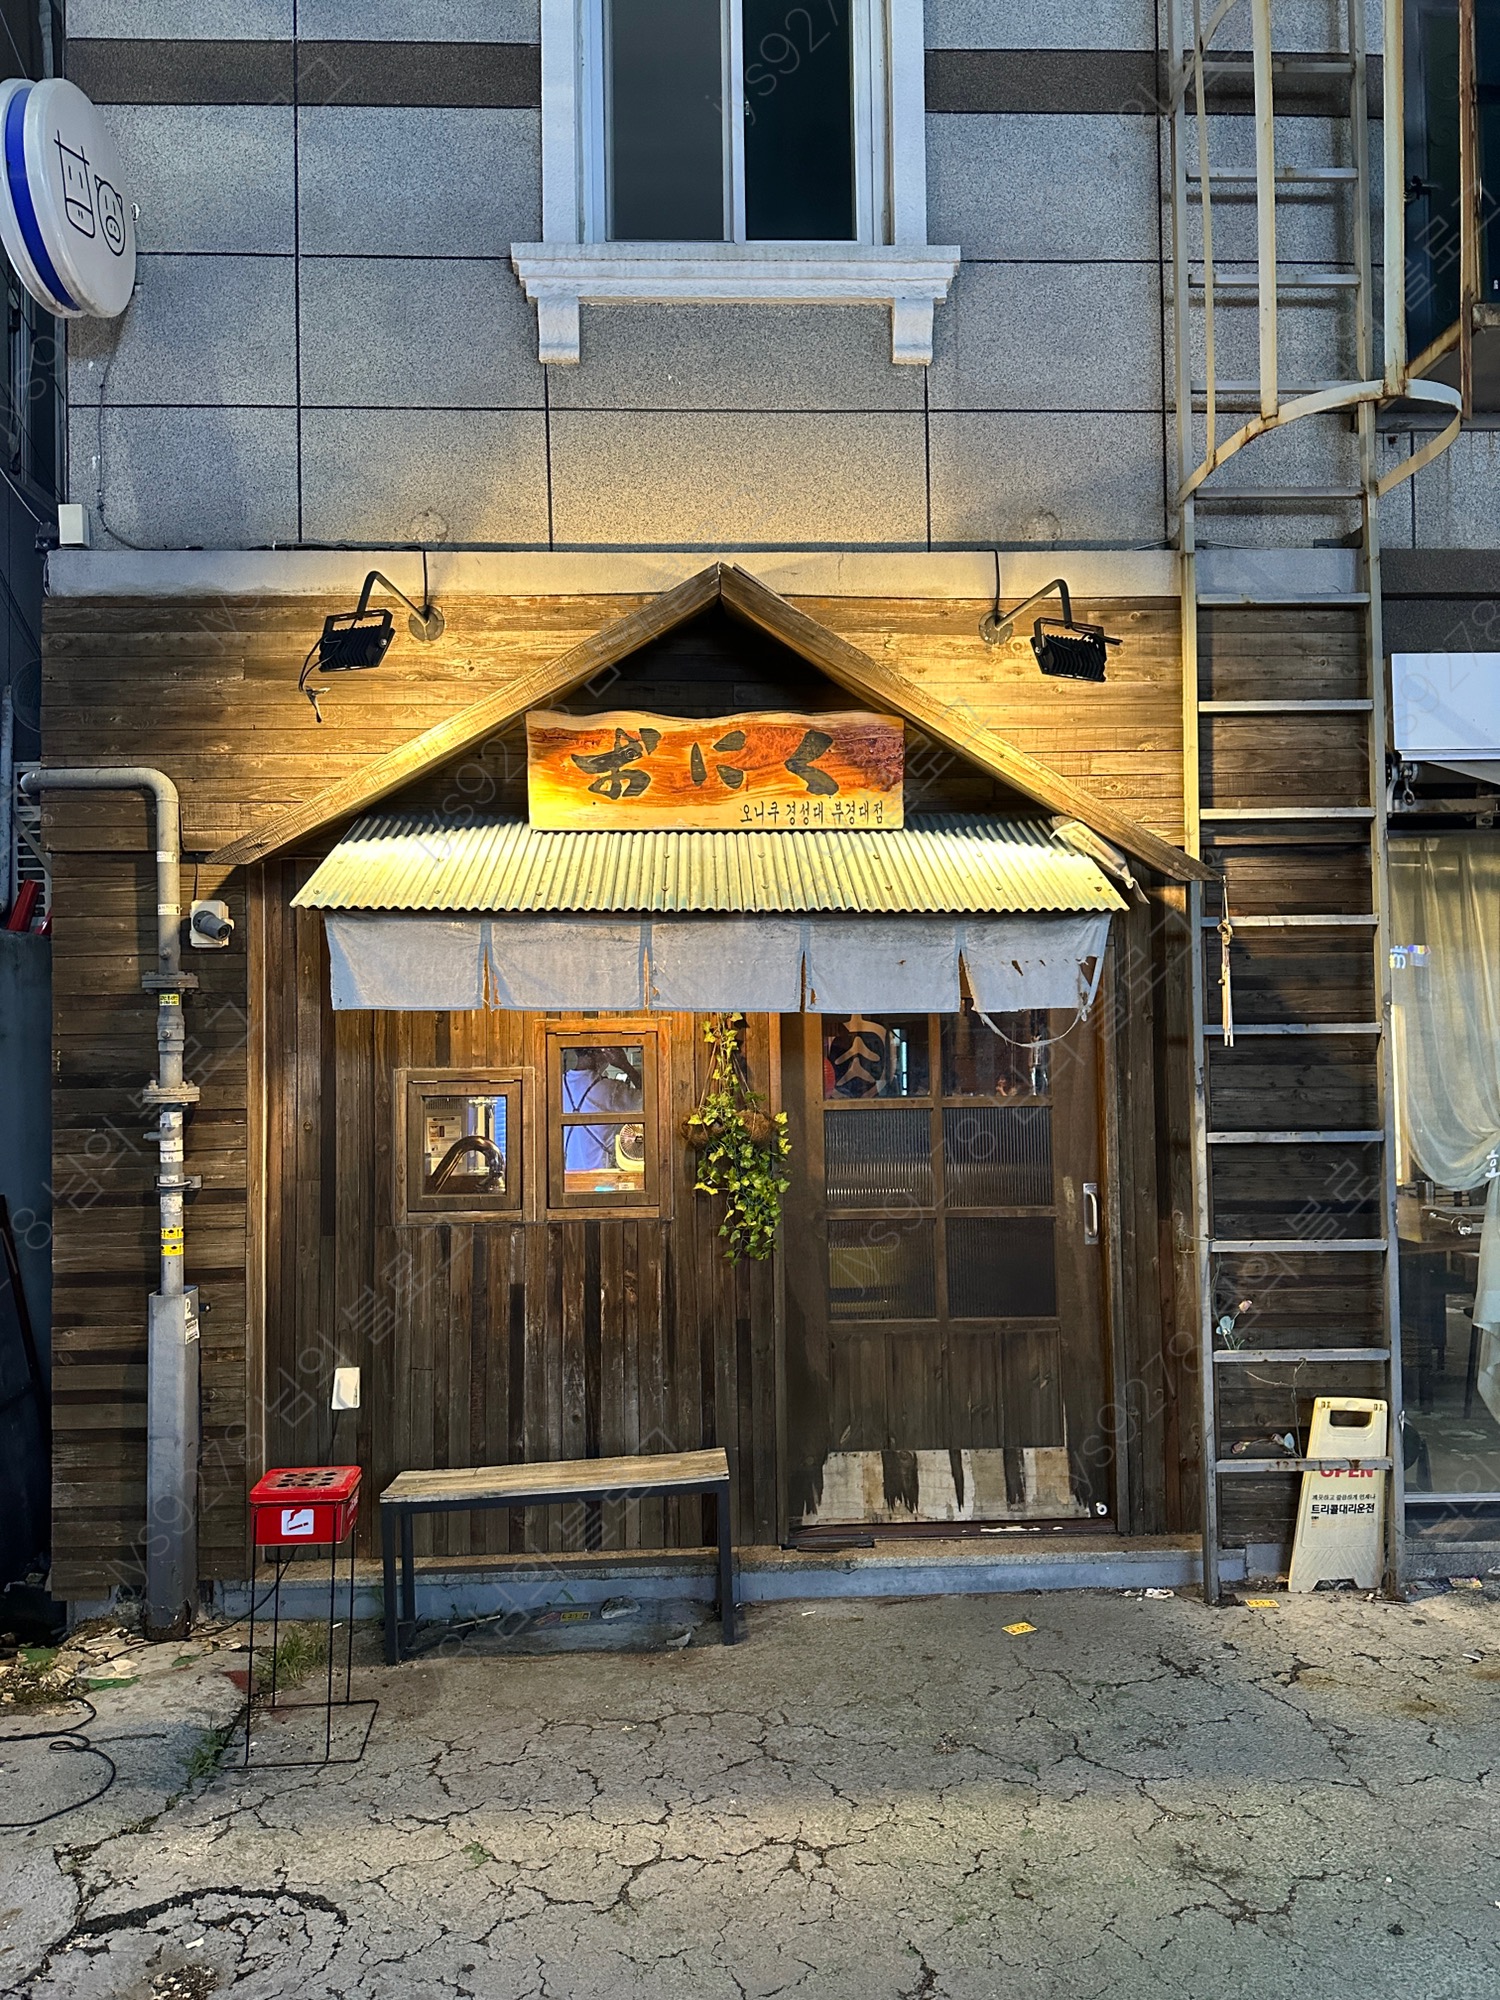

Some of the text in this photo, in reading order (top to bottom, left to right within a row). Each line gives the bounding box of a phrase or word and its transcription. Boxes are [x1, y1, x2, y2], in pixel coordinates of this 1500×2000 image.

[570, 727, 839, 800] おにく
[740, 800, 884, 826] 오니쿠 경성대 부경대점
[1311, 1503, 1375, 1514] 트리콜대리운전
